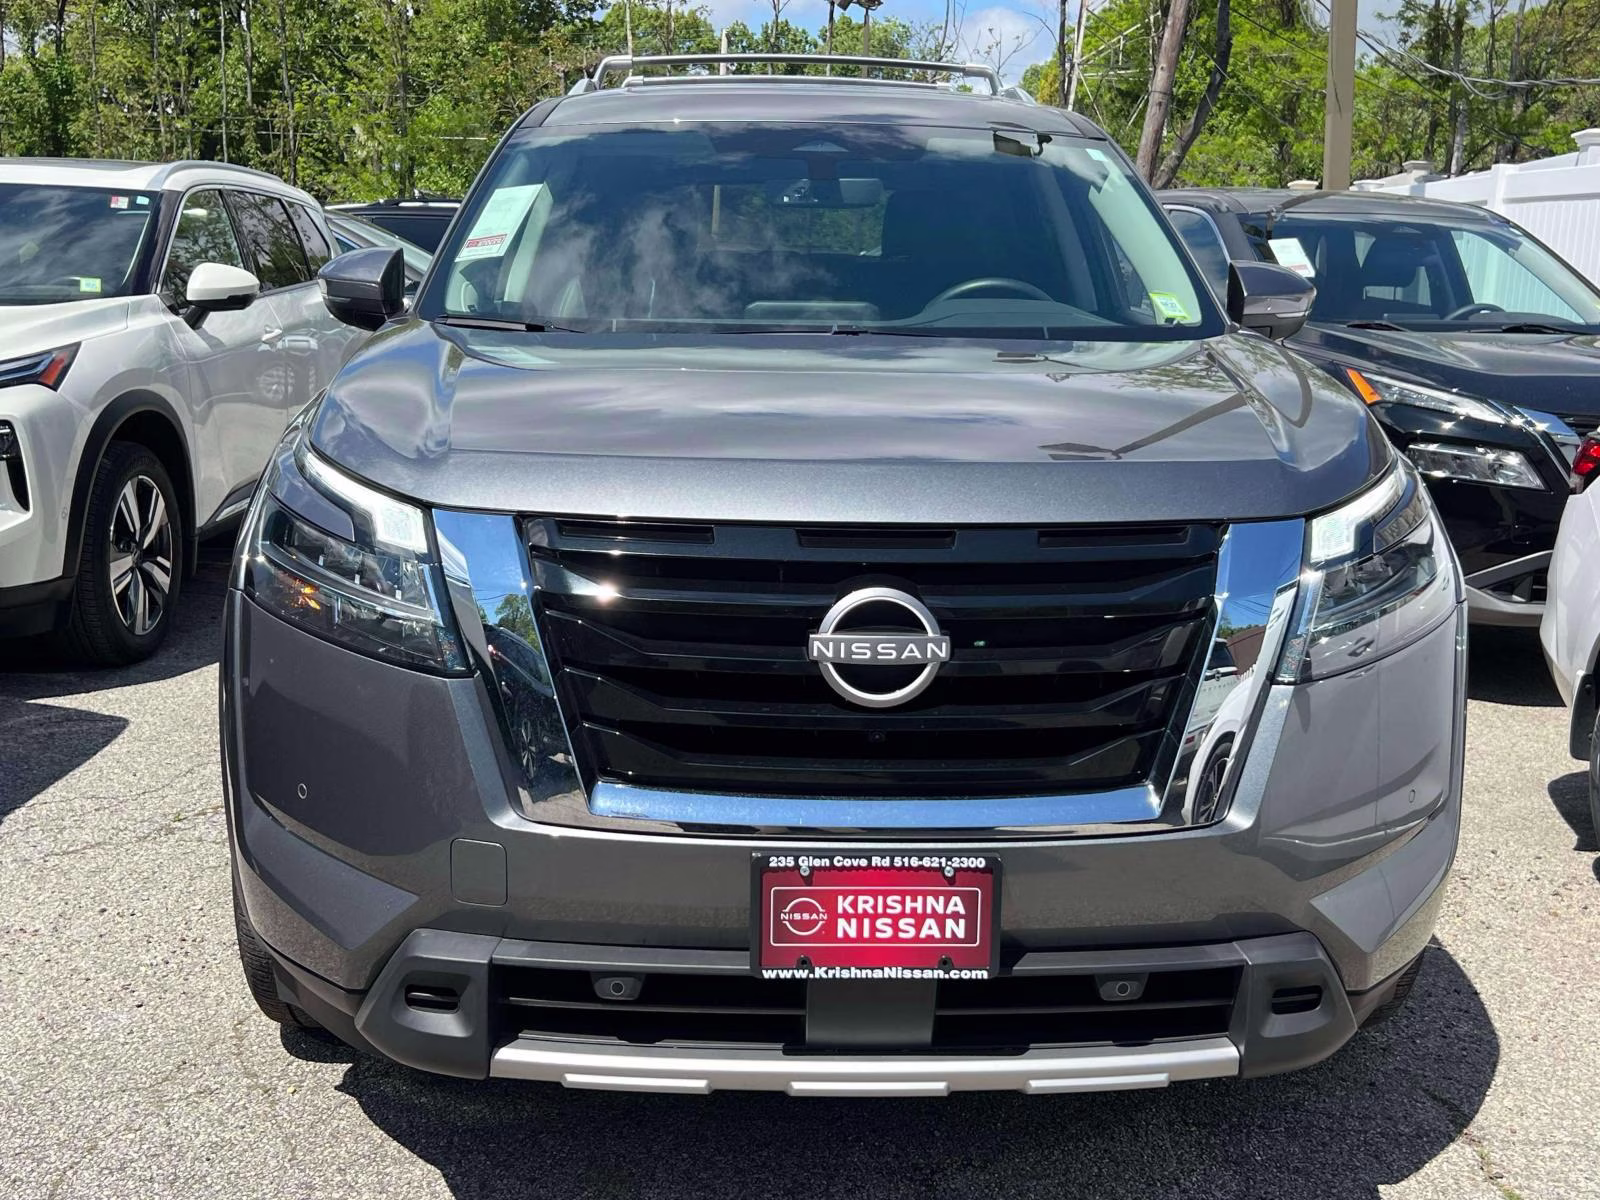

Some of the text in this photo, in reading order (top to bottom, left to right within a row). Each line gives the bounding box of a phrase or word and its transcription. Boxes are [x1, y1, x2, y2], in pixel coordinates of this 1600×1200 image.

[813, 640, 946, 660] NISSAN
[769, 855, 986, 868] 235 Glen Cove Rd 516-621-2300
[837, 895, 966, 915] KRISHNA
[780, 912, 828, 920] NISSAN
[837, 918, 966, 939] NISSAN
[762, 966, 988, 980] www.KrishnaNissan.com
